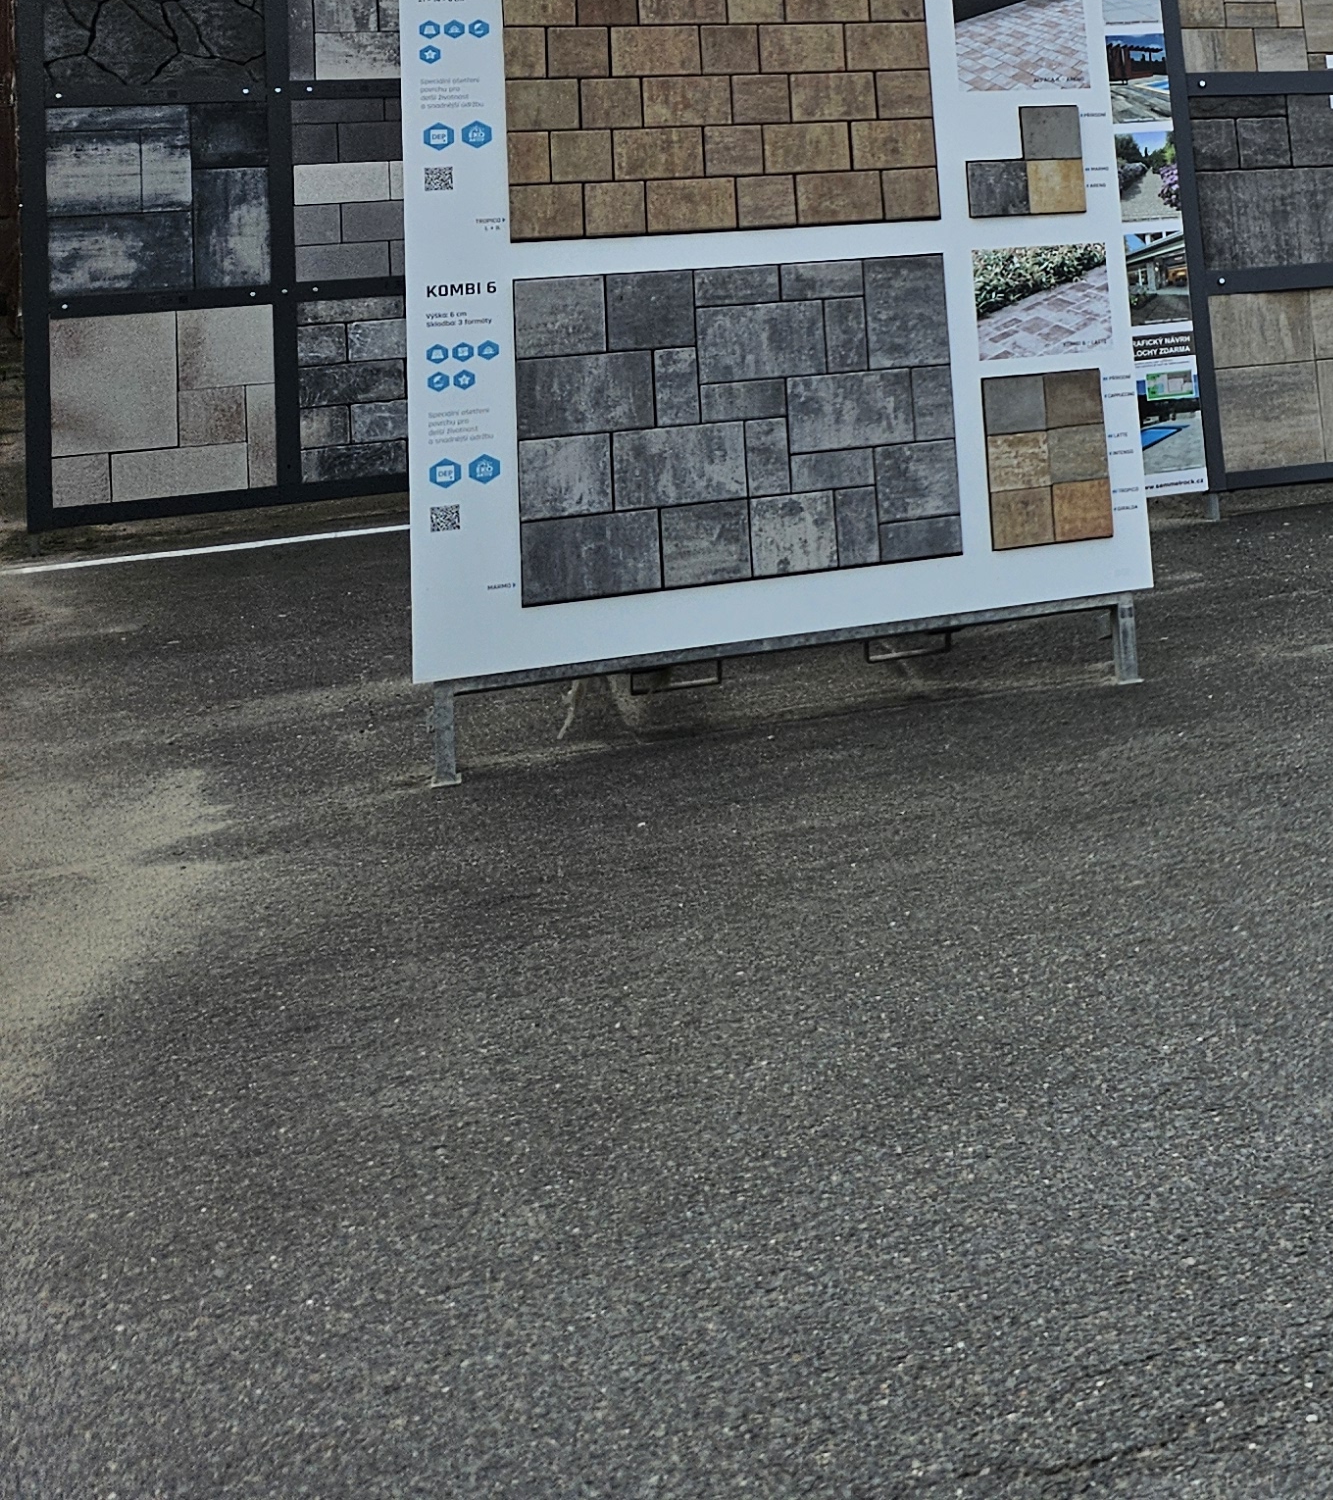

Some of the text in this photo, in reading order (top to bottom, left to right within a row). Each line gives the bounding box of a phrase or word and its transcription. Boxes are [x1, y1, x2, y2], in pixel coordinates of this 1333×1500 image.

[426, 281, 497, 298] KOMBI 6
[1145, 478, 1204, 490] ww.semmelrock.cz
